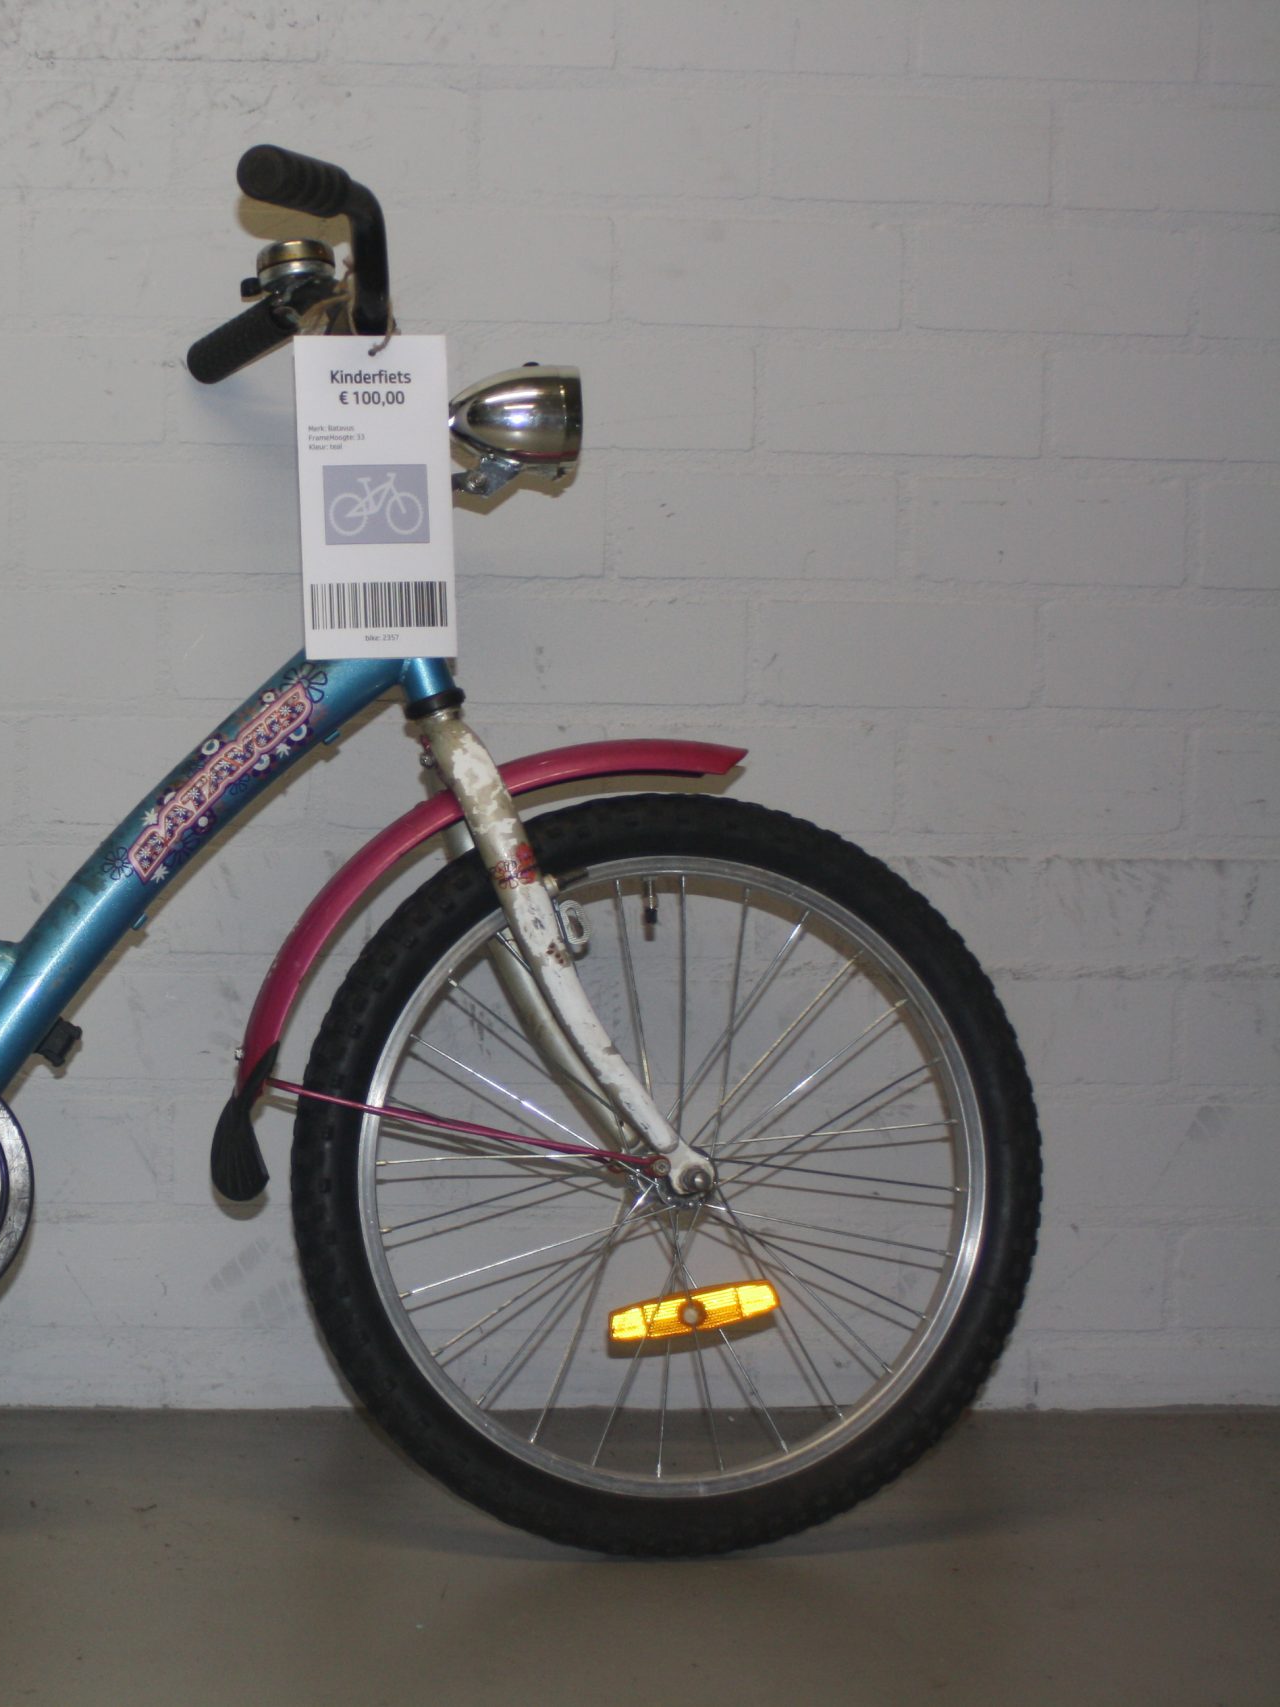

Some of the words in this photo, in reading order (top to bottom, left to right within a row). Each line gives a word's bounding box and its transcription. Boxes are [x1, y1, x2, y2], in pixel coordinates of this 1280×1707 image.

[330, 370, 412, 384] Kinderfiets
[339, 391, 350, 405] €
[353, 391, 405, 407] 100,00
[365, 634, 380, 642] bike:
[130, 685, 310, 880] BATAVUS
